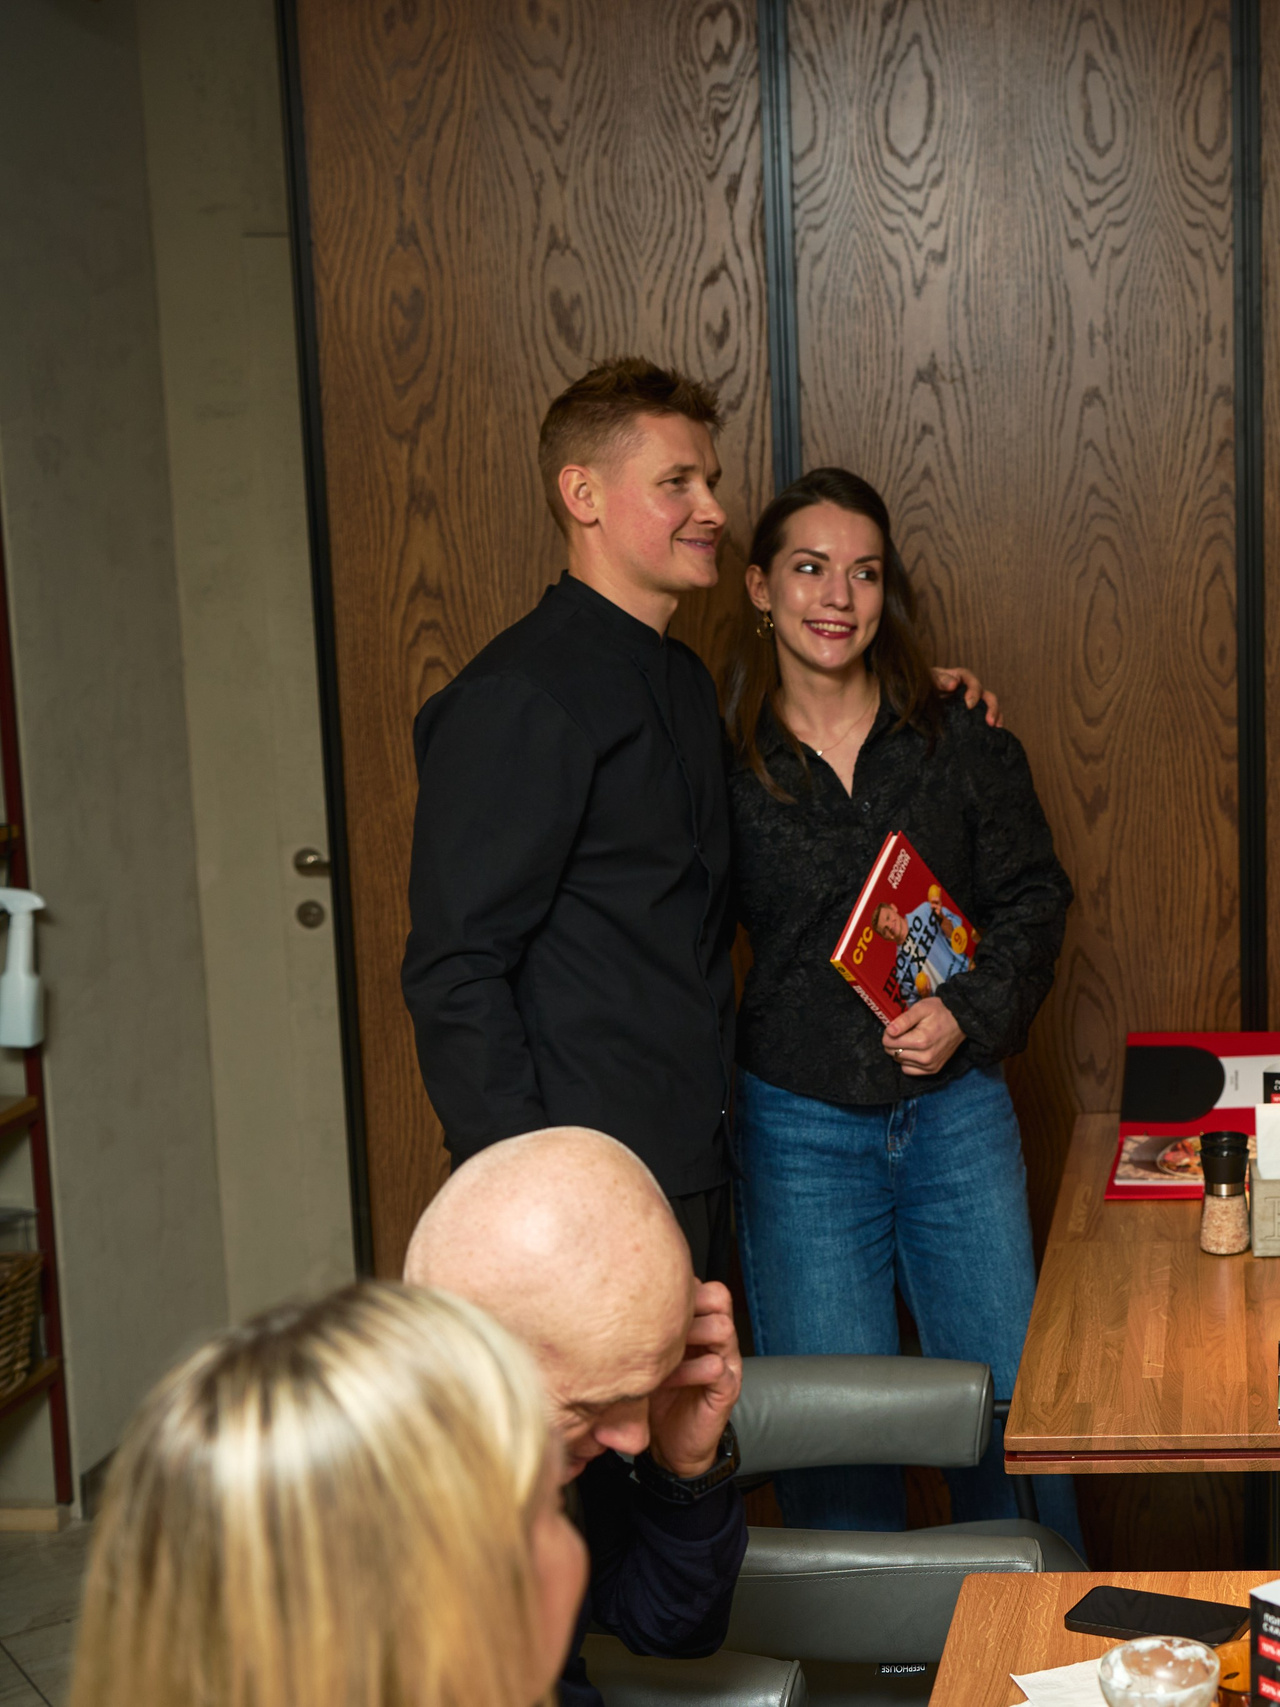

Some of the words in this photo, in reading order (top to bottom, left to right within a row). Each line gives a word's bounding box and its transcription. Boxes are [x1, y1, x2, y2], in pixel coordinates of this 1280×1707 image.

[852, 926, 874, 965] СТС
[883, 915, 923, 998] ПРОСТО
[893, 908, 944, 1013] КУХНЯ
[1262, 1622, 1268, 1632] С
[881, 1664, 926, 1673] DEEPHOUSE
